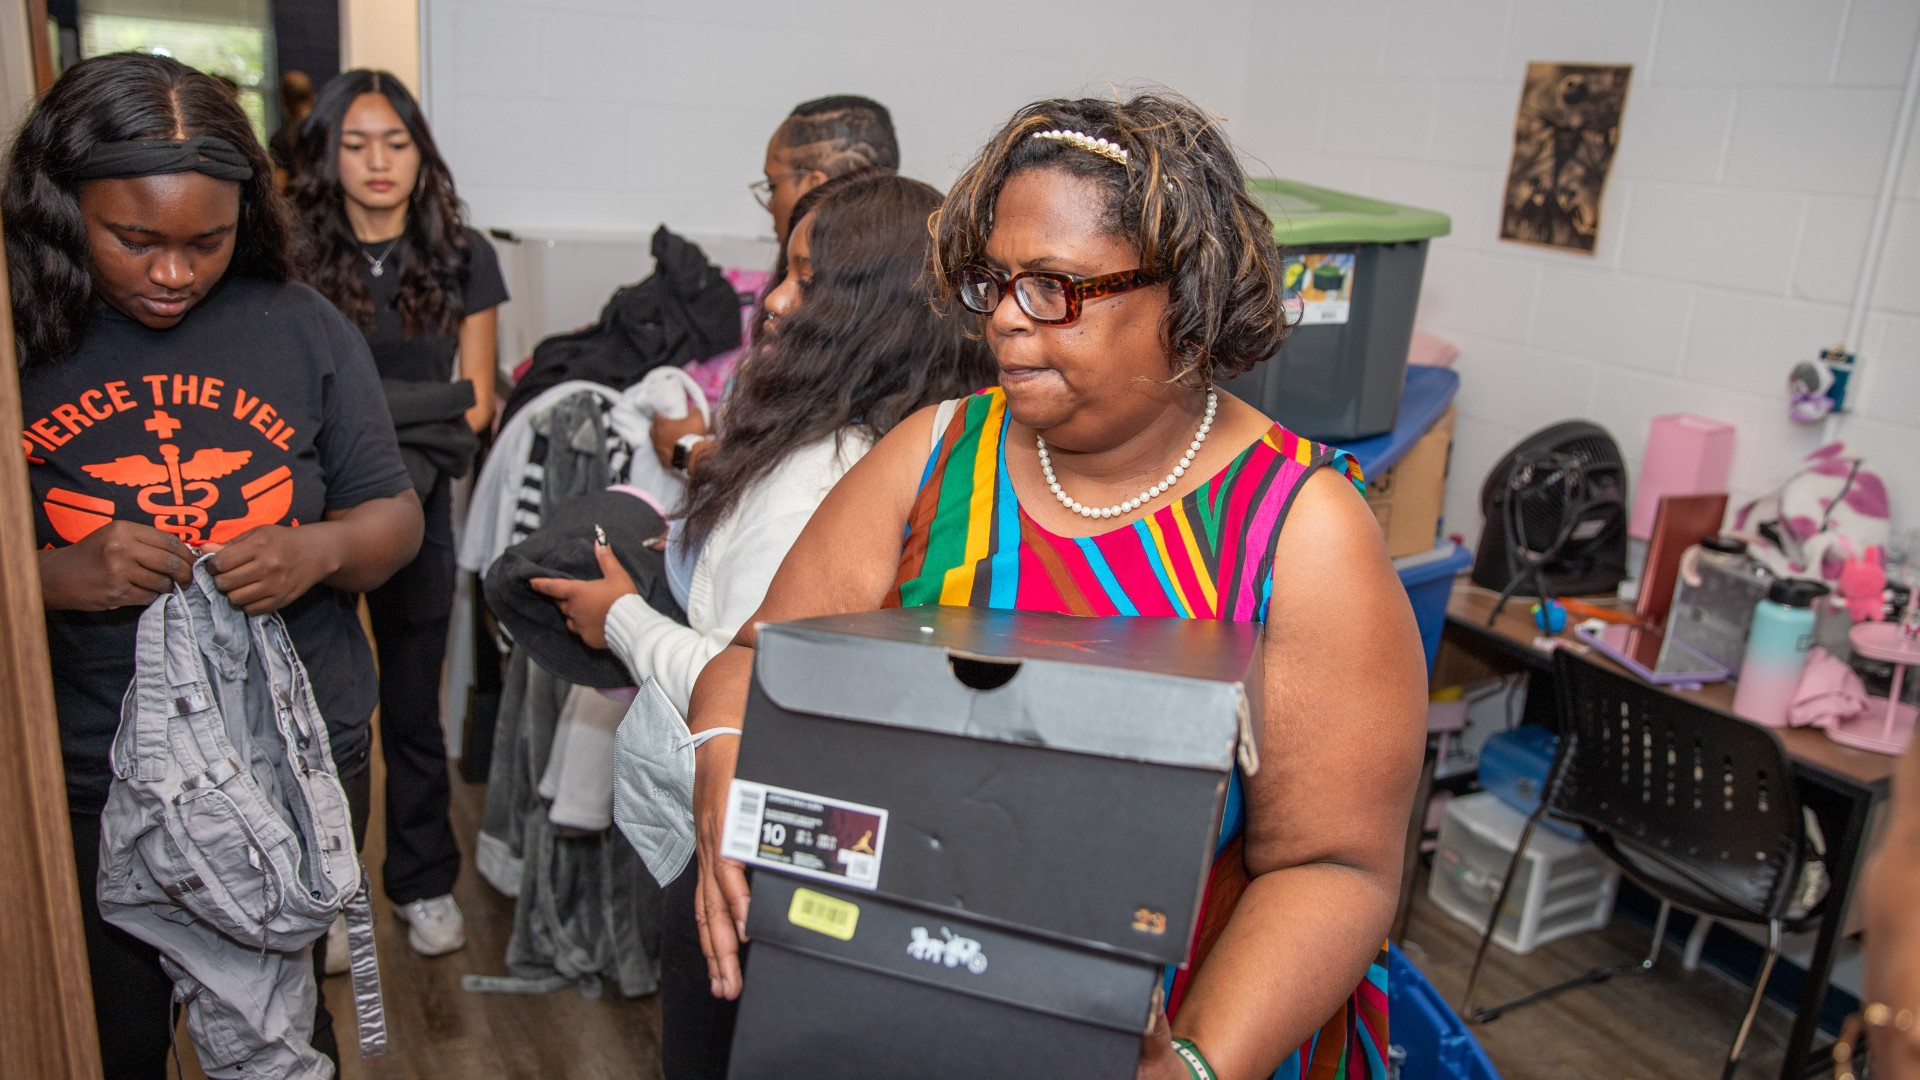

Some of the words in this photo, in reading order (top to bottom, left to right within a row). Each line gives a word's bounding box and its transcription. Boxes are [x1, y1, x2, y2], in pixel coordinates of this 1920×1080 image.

[143, 373, 225, 410] THE
[234, 388, 295, 452] VEIL
[762, 822, 787, 846] 10
[1132, 908, 1167, 935] 23
